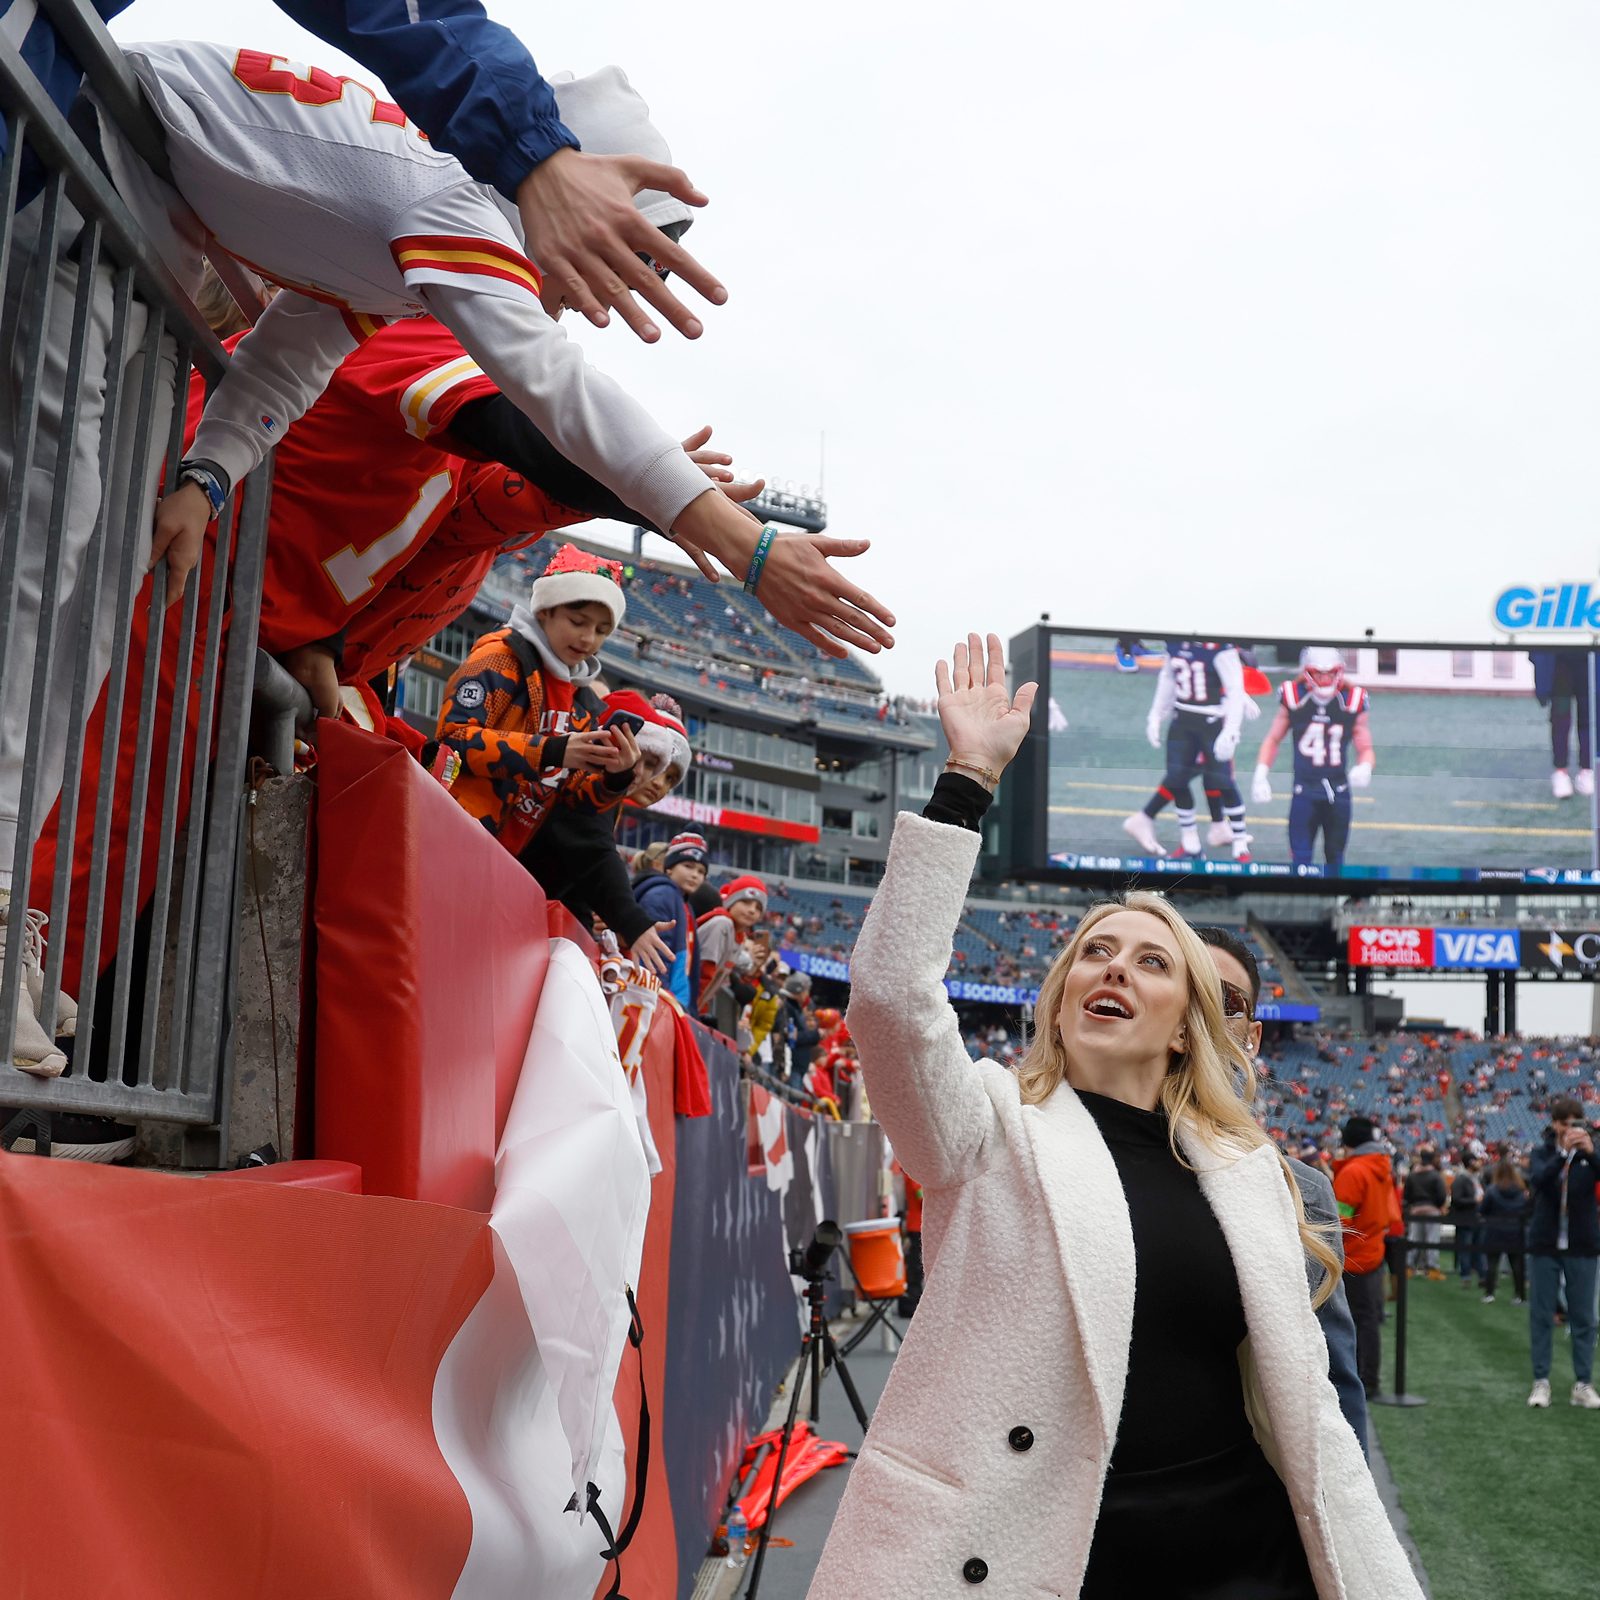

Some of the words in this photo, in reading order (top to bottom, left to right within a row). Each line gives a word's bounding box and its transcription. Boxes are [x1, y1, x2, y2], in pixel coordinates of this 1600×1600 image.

[321, 468, 453, 606] 1
[761, 528, 773, 547] HAVE
[1171, 657, 1207, 701] 31
[1298, 722, 1344, 767] 41
[1378, 929, 1421, 947] CVS
[1438, 932, 1518, 963] VISA
[808, 955, 848, 982] SOCIOS
